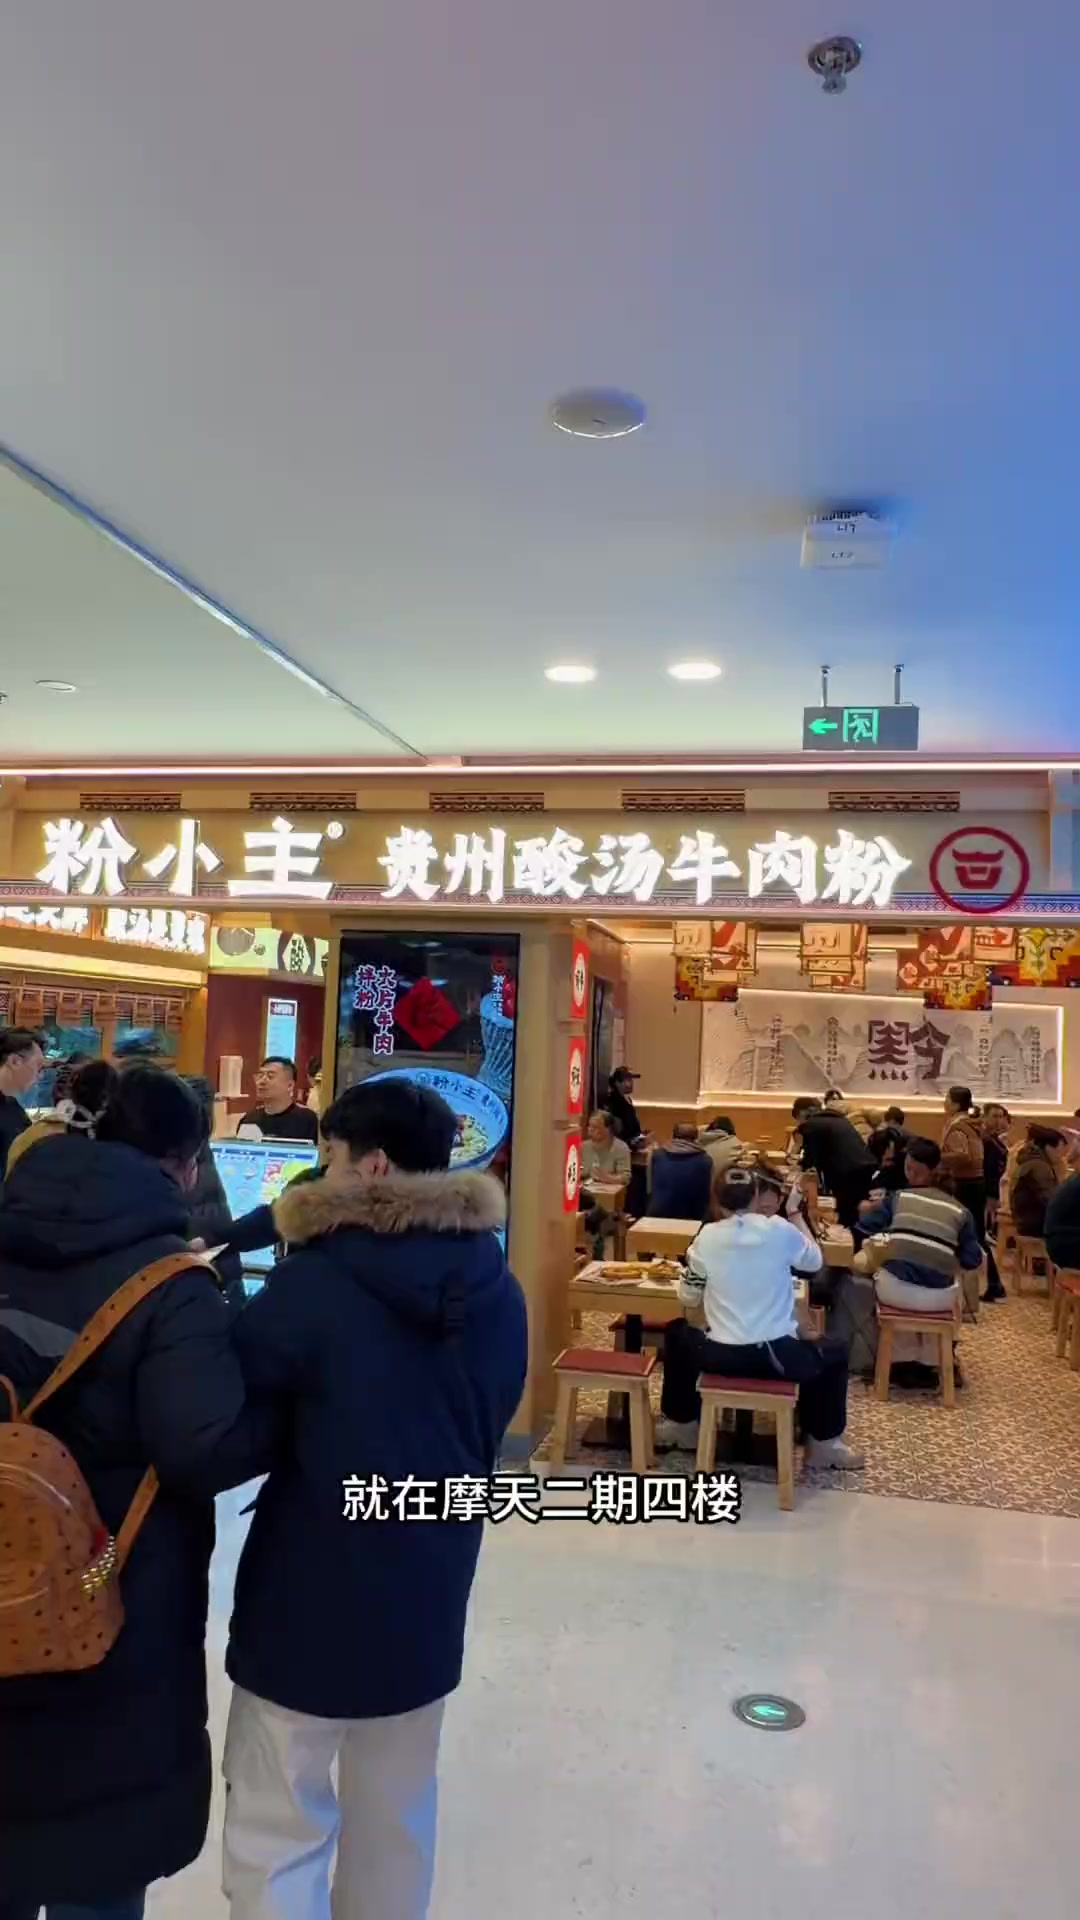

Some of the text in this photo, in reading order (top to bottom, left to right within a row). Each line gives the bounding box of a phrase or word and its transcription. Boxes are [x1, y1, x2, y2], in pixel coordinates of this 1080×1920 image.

[36, 815, 334, 900] 粉小主
[377, 826, 912, 907] 贵州酸汤牛肉粉
[373, 965, 397, 1055] 大片牛肉
